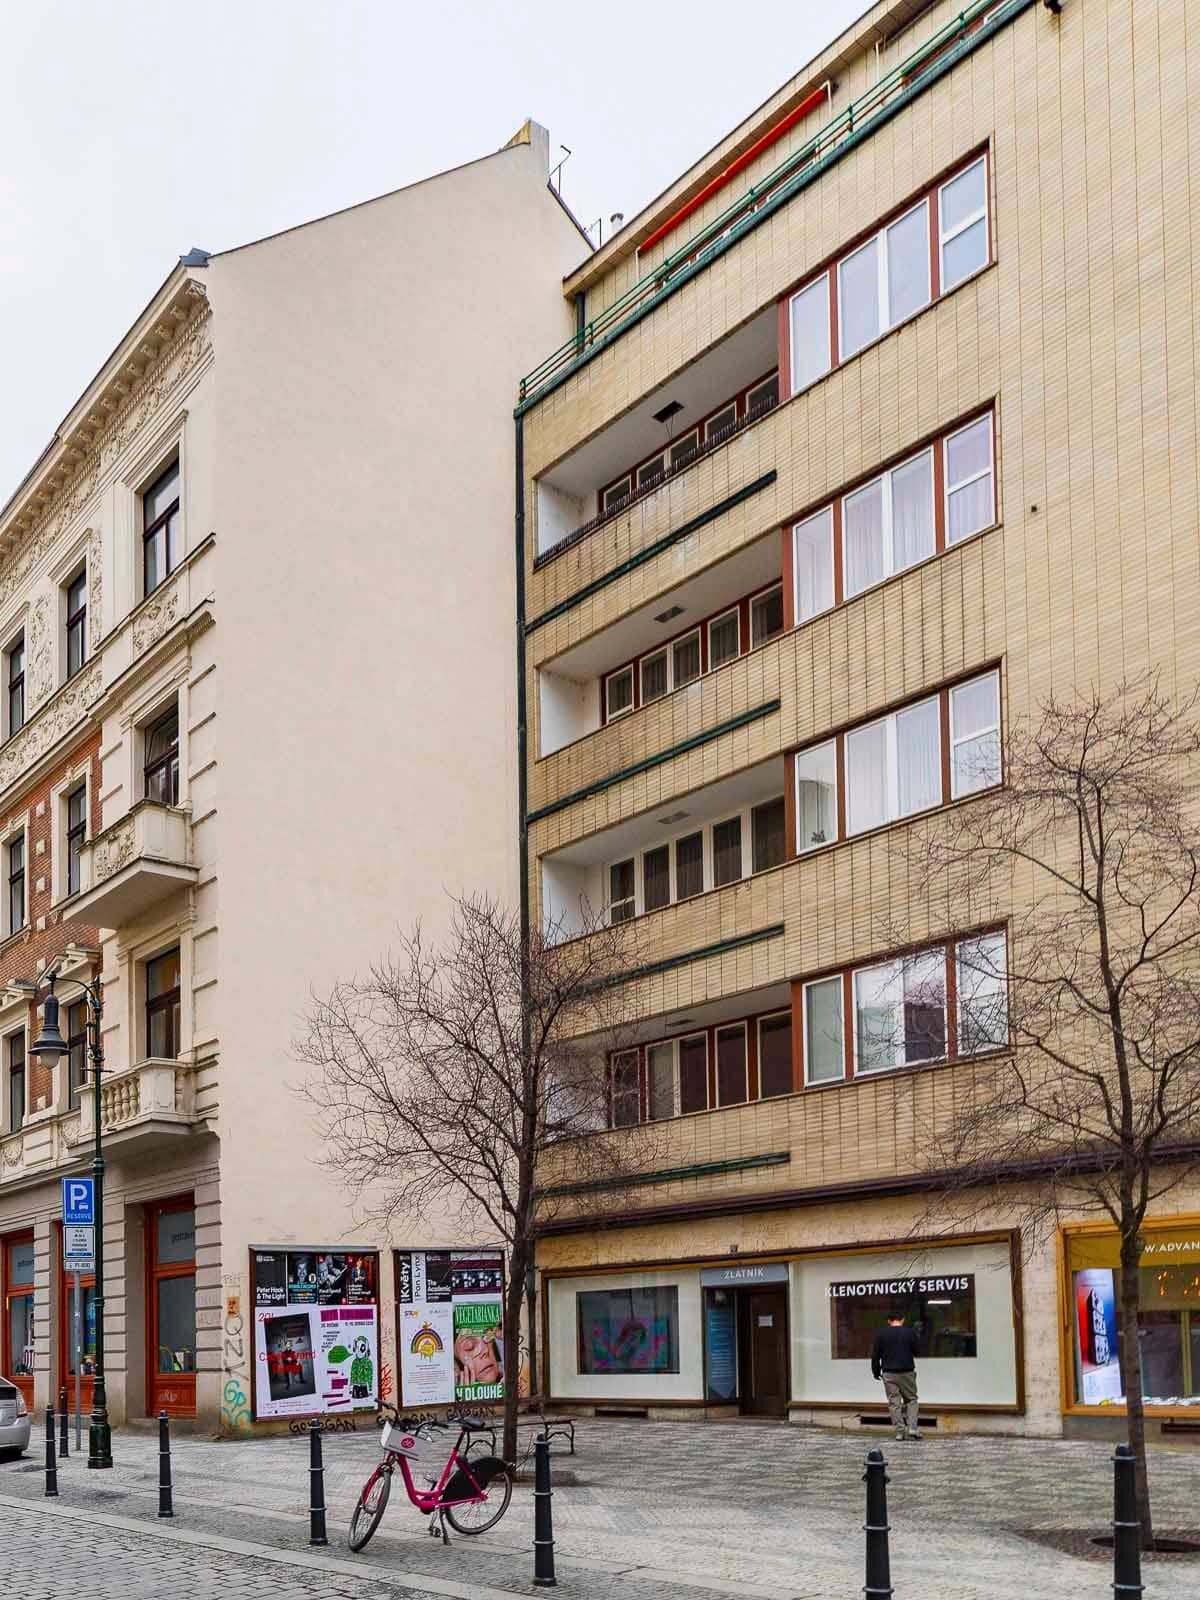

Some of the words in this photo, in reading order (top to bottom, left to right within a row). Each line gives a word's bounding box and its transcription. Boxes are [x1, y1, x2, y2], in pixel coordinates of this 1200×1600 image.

[70, 1184, 88, 1210] P
[824, 1278, 916, 1297] KLENOTNICKÝ
[918, 1276, 969, 1293] SERVIS
[464, 1381, 503, 1401] DLOUHÉ
